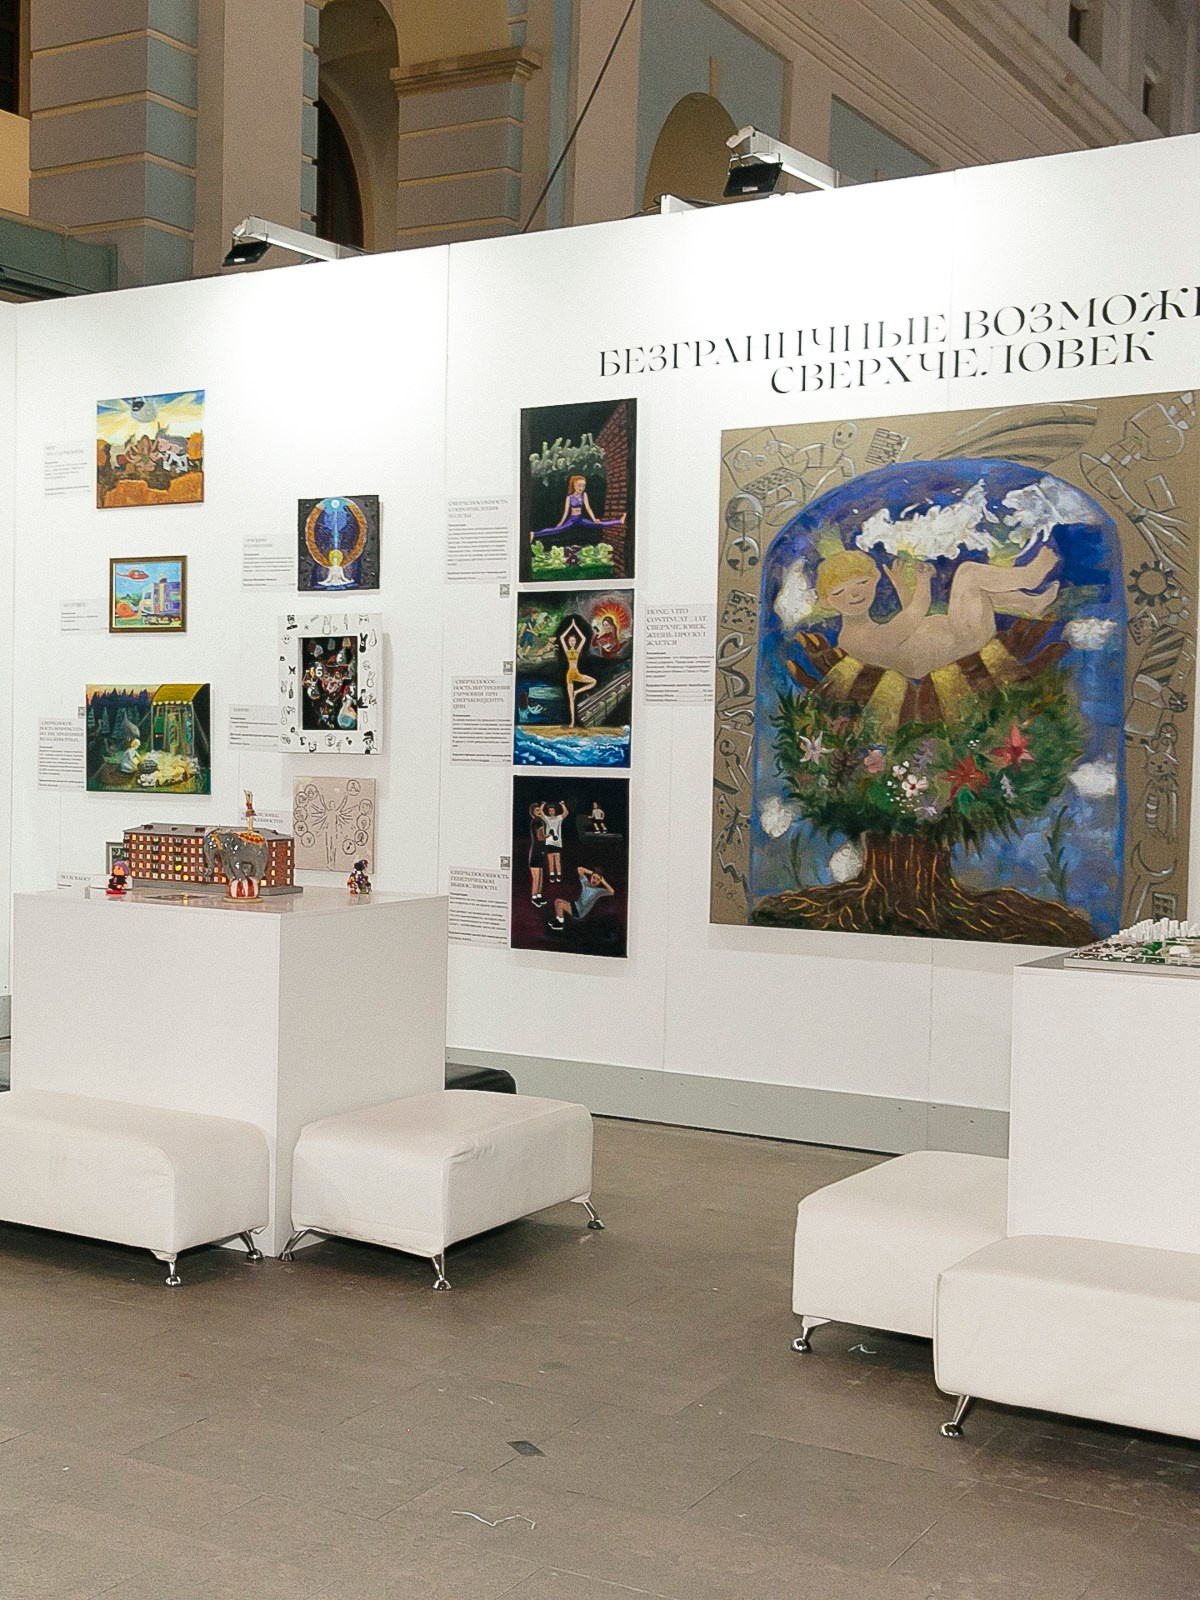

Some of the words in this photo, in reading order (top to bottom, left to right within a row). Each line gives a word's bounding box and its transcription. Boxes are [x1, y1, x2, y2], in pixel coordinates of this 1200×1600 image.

[599, 313, 947, 377] БЕЗГРАНИЧНЫЕ
[964, 286, 1200, 340] ВОЗМОЖ
[770, 330, 1155, 394] СВЕРХЧЕЛОВЕК
